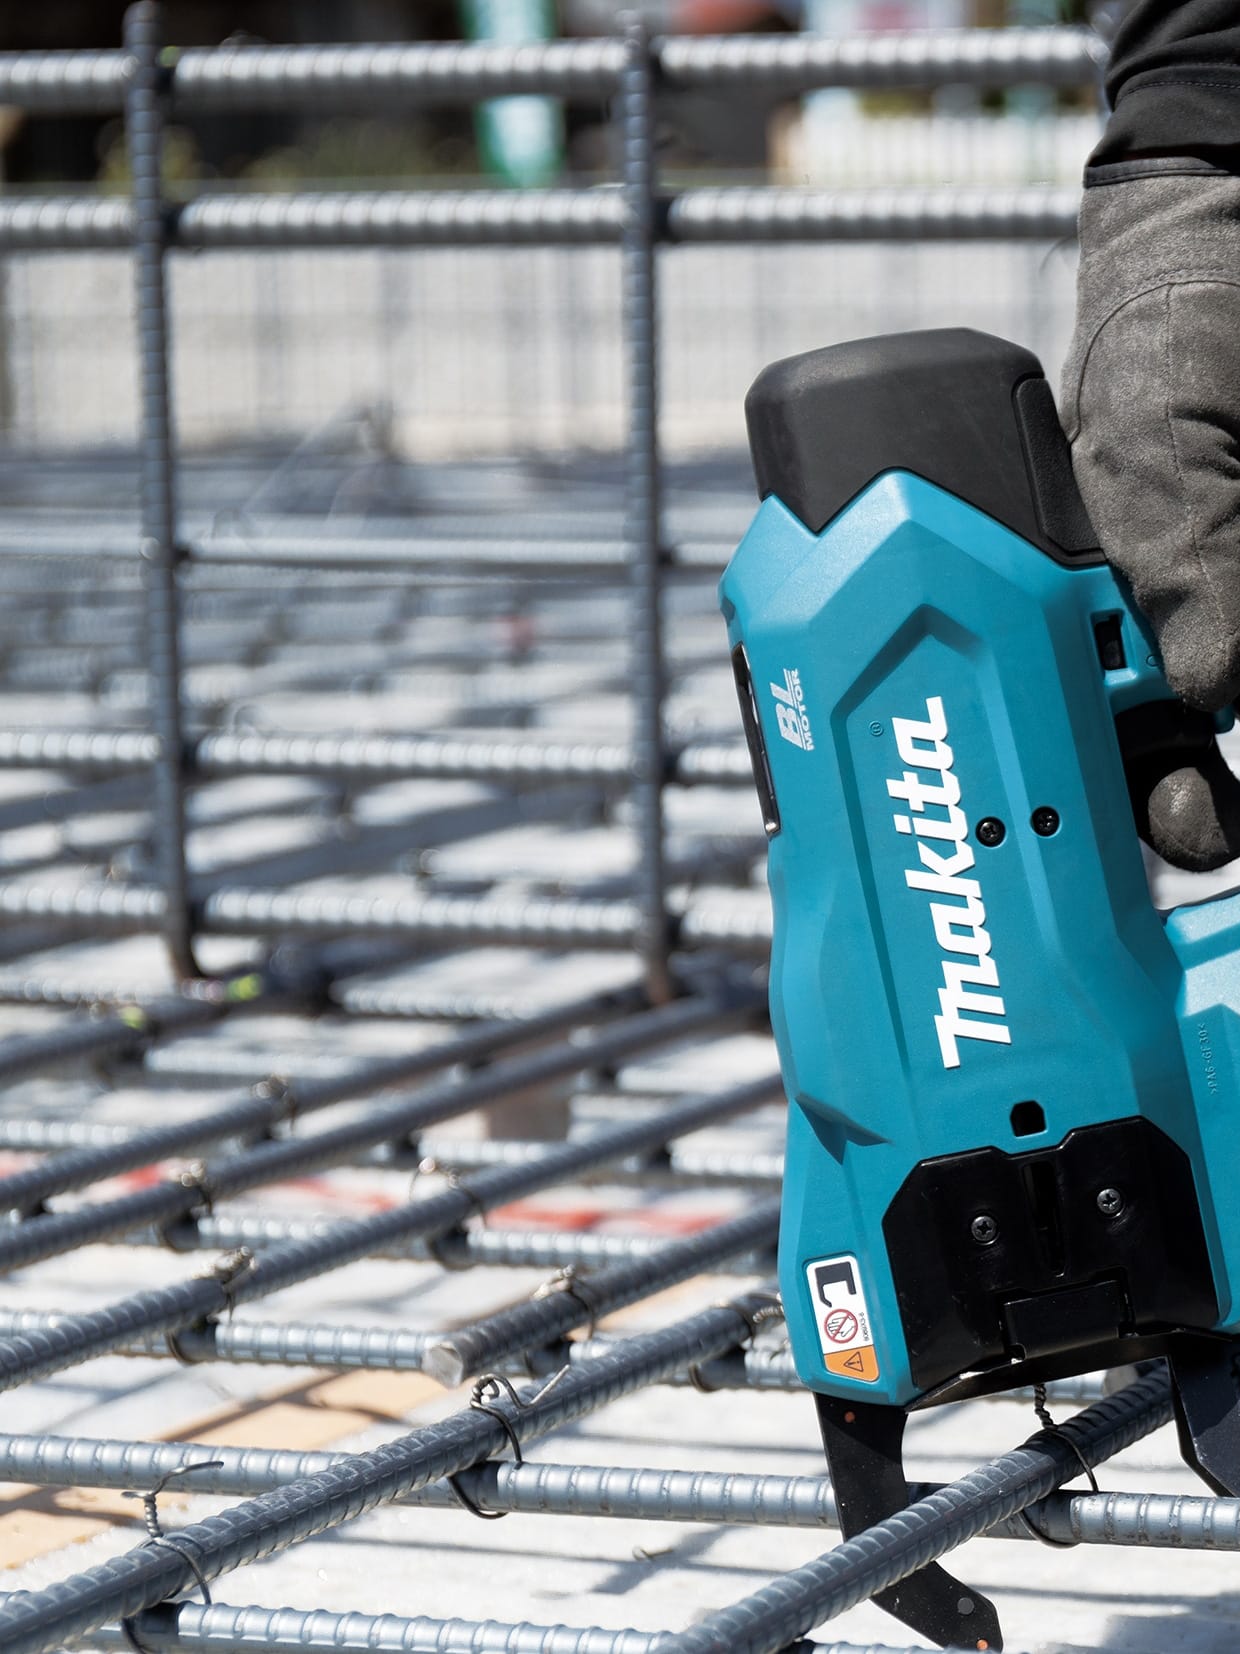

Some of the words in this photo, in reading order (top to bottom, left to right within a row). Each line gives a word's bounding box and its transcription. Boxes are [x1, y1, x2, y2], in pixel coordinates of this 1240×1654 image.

[769, 668, 805, 750] BL
[791, 668, 815, 751] MOTOR
[886, 695, 1012, 1069] makita
